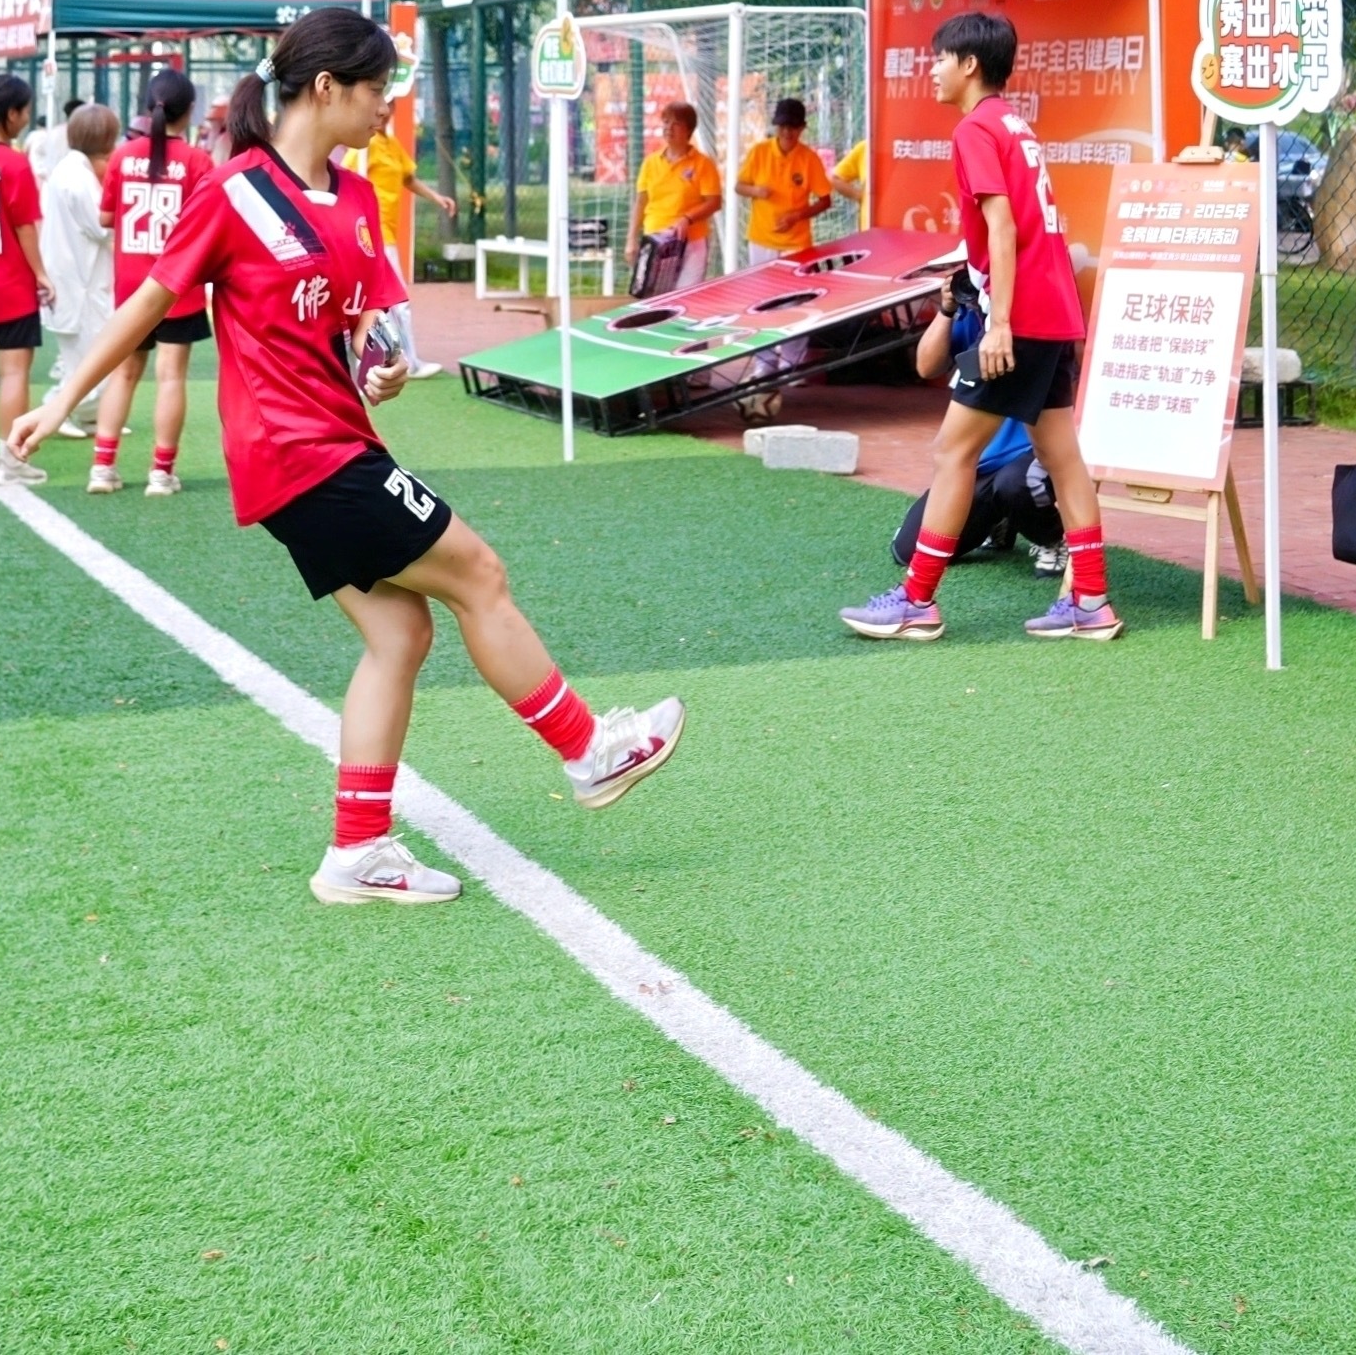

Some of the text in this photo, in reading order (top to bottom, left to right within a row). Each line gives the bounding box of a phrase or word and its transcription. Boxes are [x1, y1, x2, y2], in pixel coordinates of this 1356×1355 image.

[121, 155, 187, 181] 顺德协
[120, 180, 184, 255] 28
[290, 274, 368, 322] 佛山
[1121, 293, 1215, 325] 足球保龄
[383, 467, 438, 523] 2
